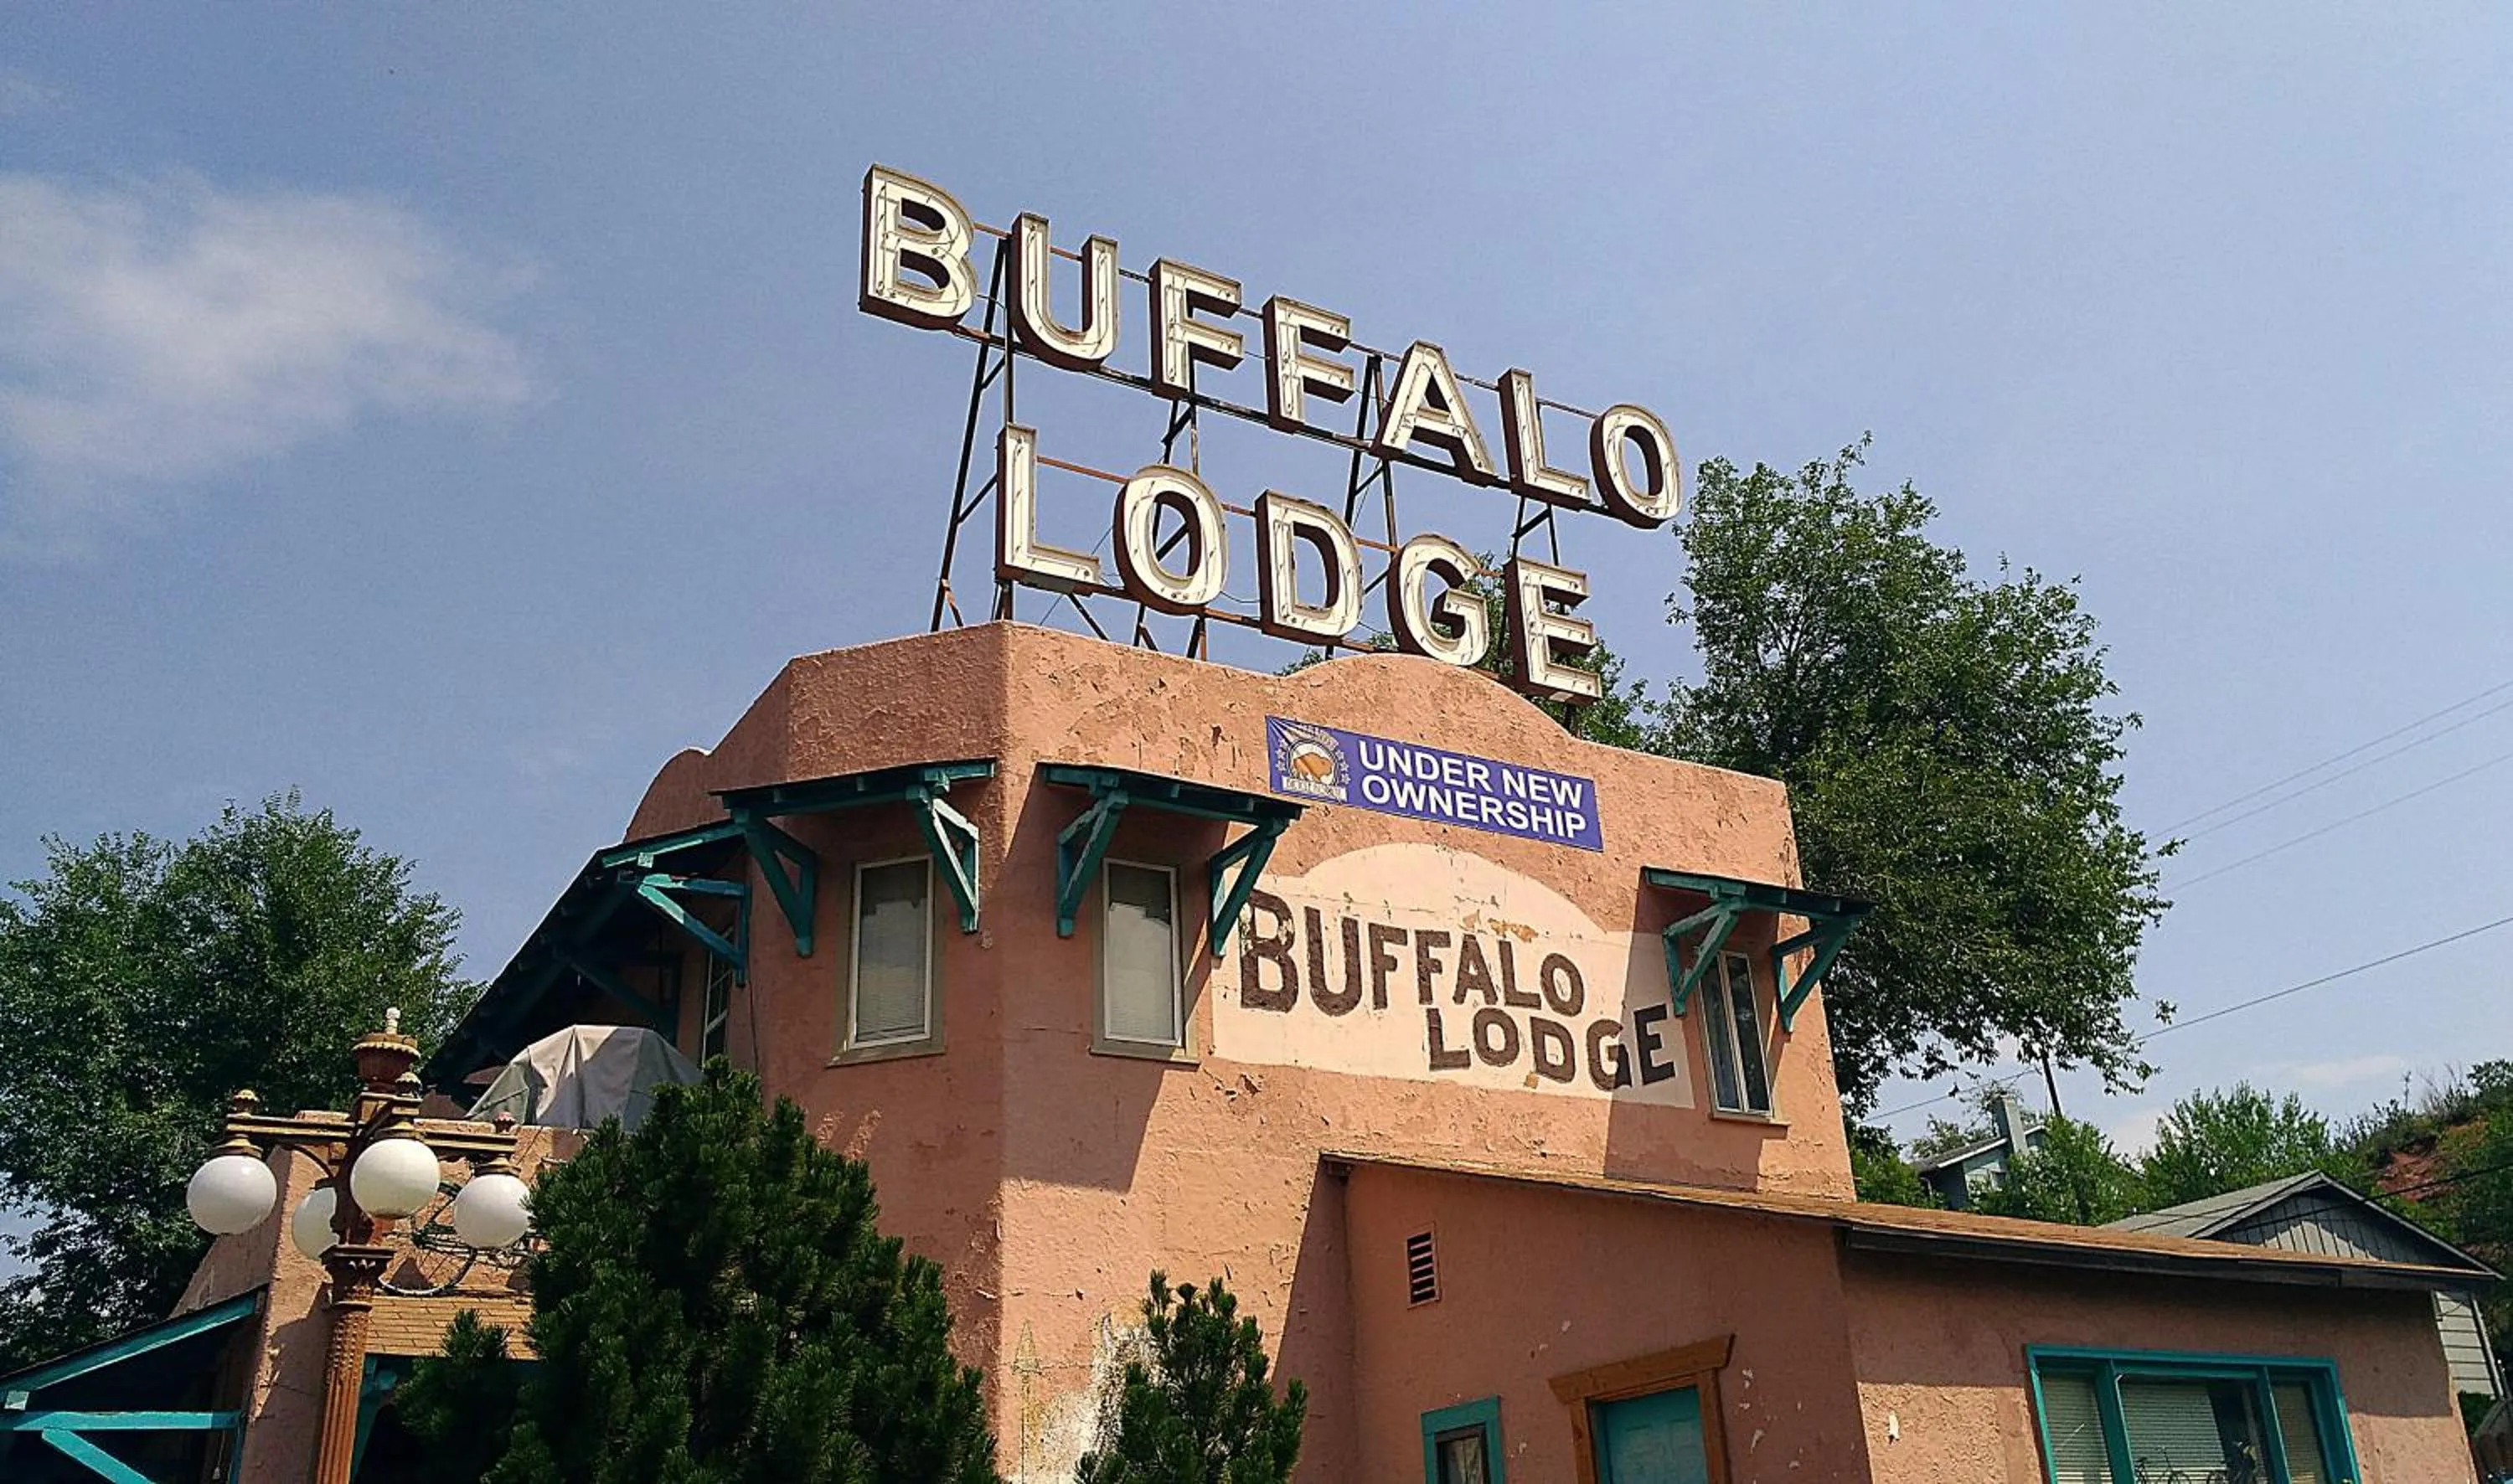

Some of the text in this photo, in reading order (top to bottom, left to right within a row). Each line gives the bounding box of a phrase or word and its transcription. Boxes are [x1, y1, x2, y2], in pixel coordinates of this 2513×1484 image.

[859, 163, 1681, 528] BUFFALO
[997, 423, 1602, 705] LODGE
[1359, 739, 1583, 808] UNDER NEW
[1361, 774, 1586, 838] OWNERSHIP
[1240, 889, 1585, 1017] BUFFALO
[1427, 1004, 1675, 1091] LODGE
